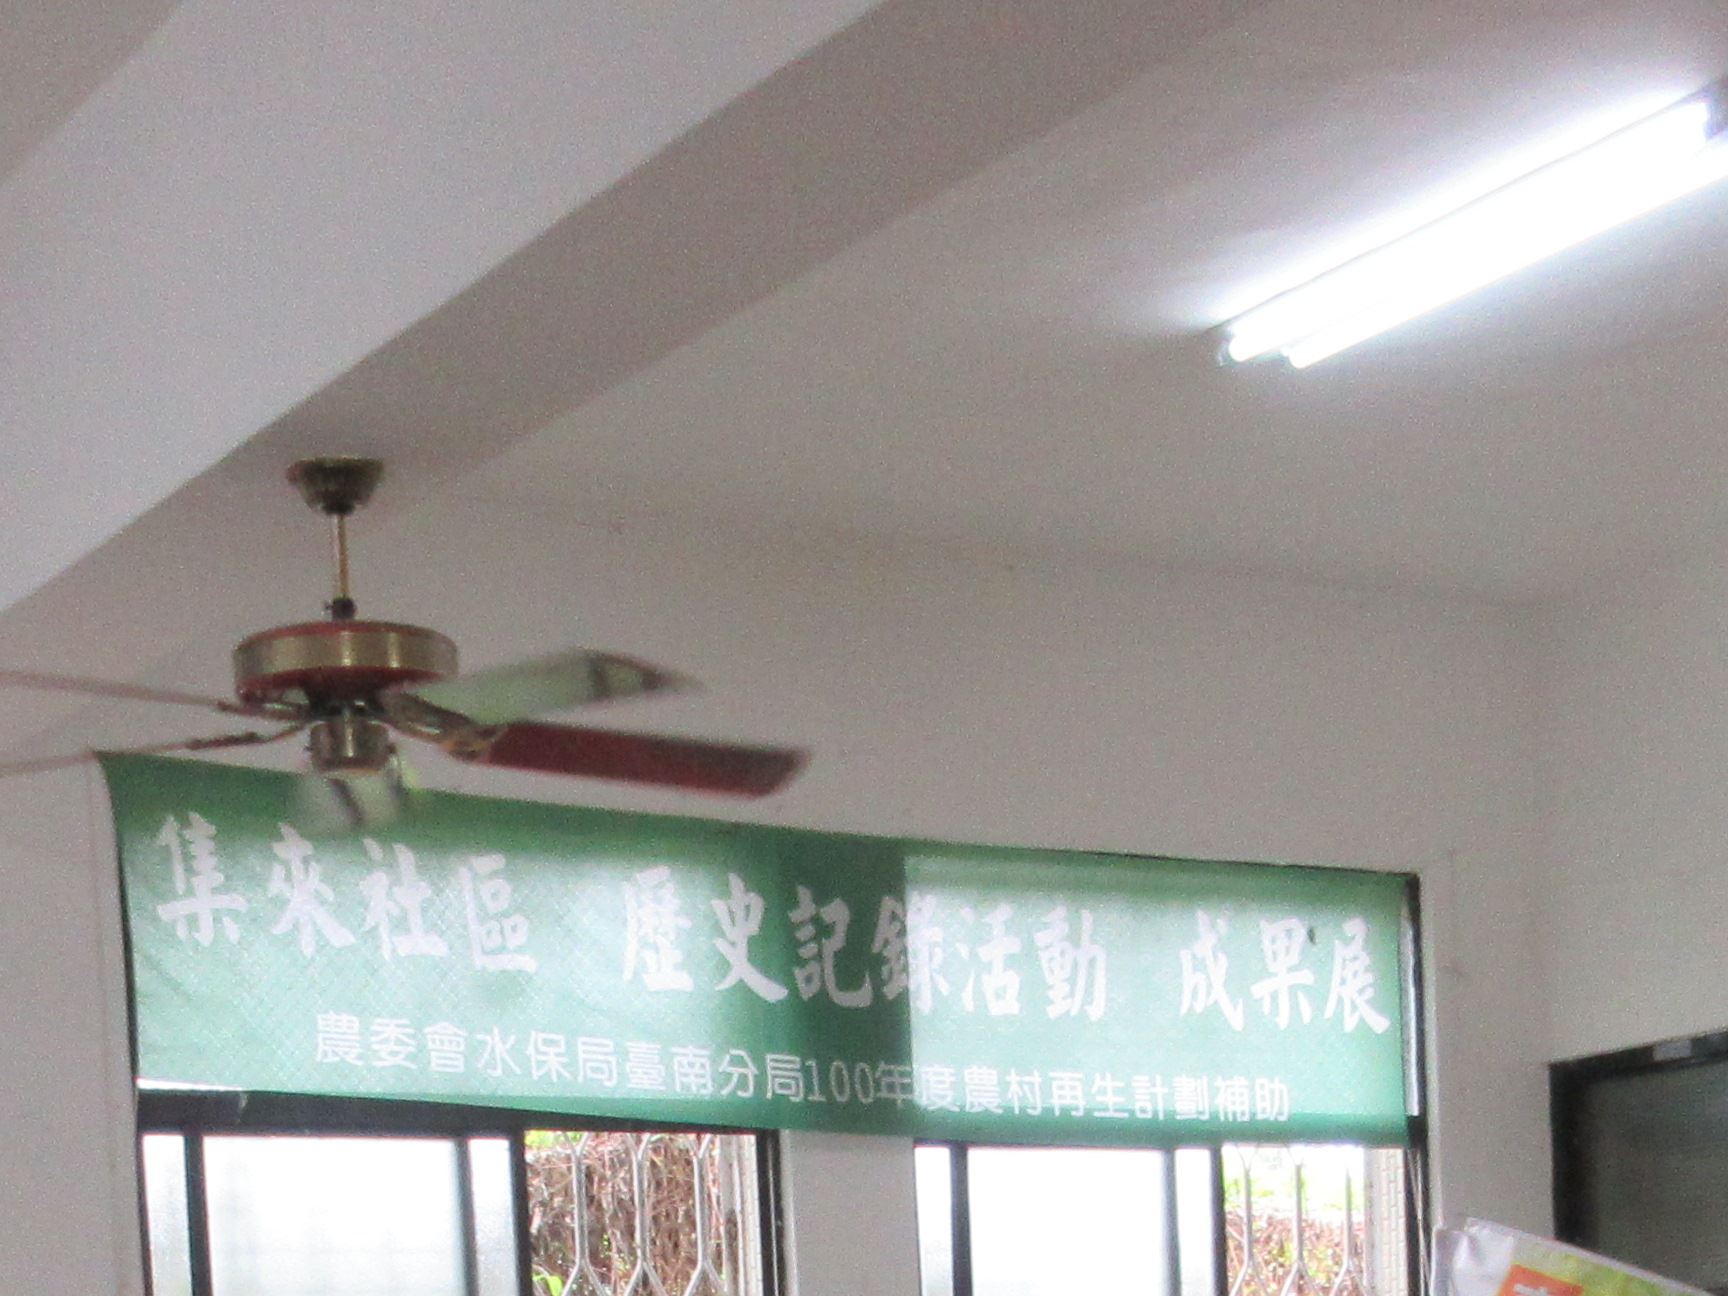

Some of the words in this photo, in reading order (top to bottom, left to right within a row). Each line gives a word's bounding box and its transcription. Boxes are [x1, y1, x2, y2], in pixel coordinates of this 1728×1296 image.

[155, 811, 537, 974] 集來社區
[1178, 910, 1392, 1035] 成果展
